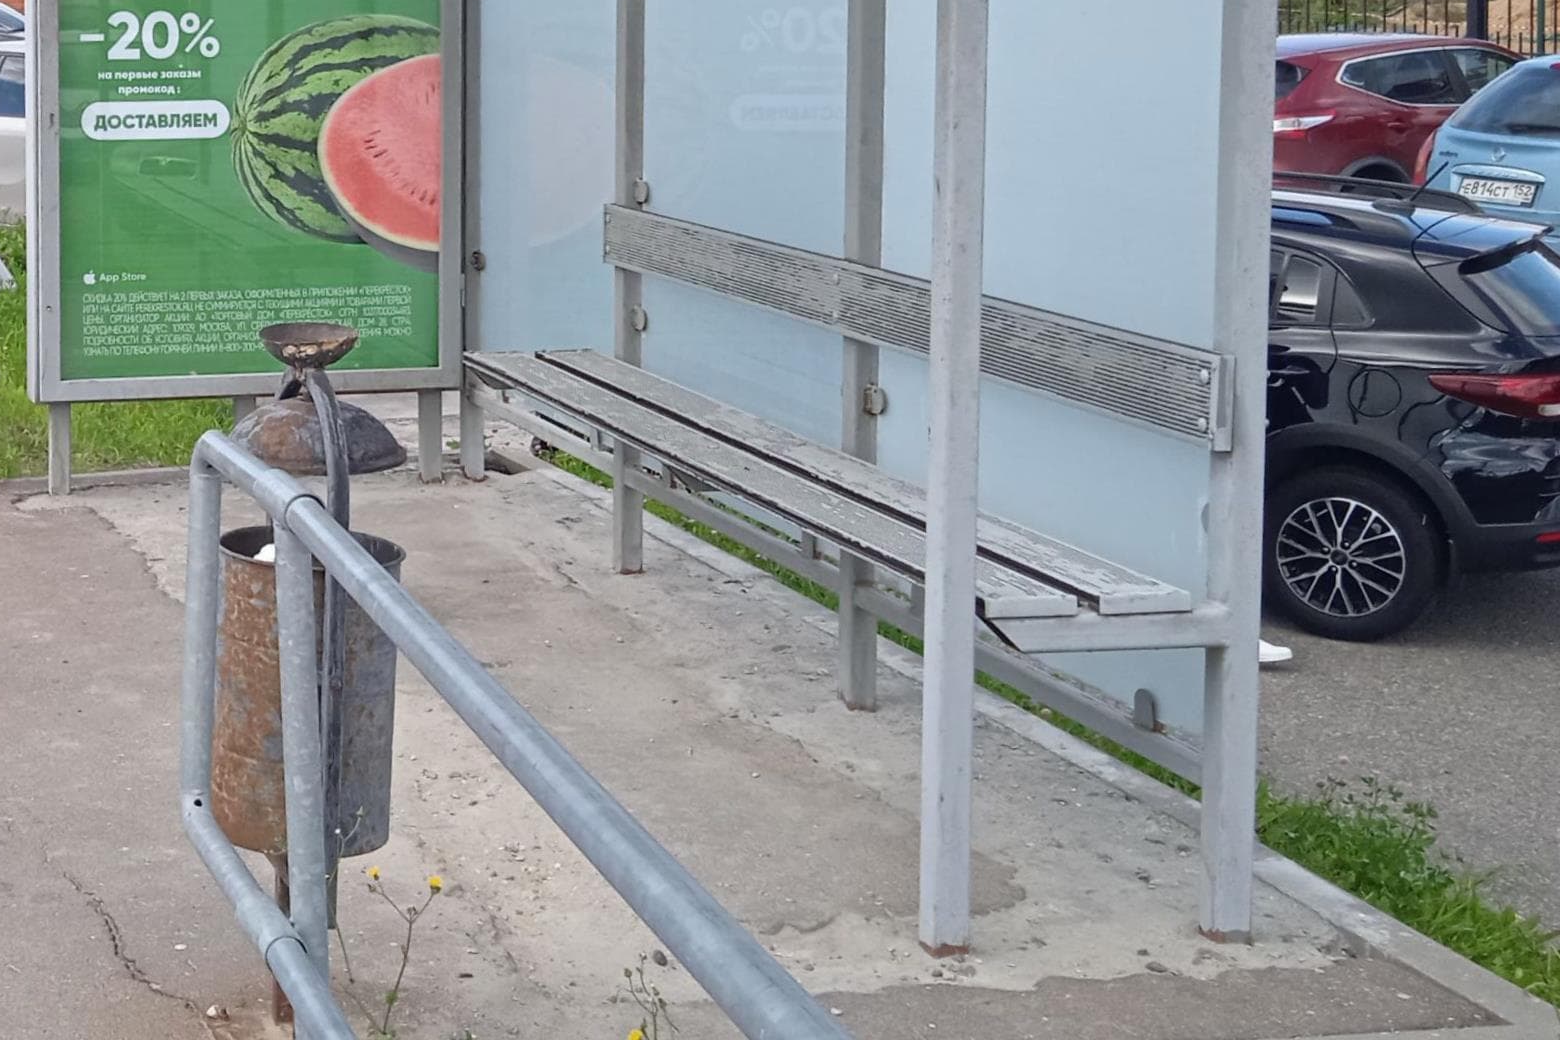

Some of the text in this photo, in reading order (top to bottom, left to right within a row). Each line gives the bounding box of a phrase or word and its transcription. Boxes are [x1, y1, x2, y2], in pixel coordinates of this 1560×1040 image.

[80, 9, 220, 61] -20%
[97, 70, 202, 81] на первые заказы
[94, 113, 218, 132] ДОСТАВЛЯЕМ
[99, 271, 147, 284] App Store
